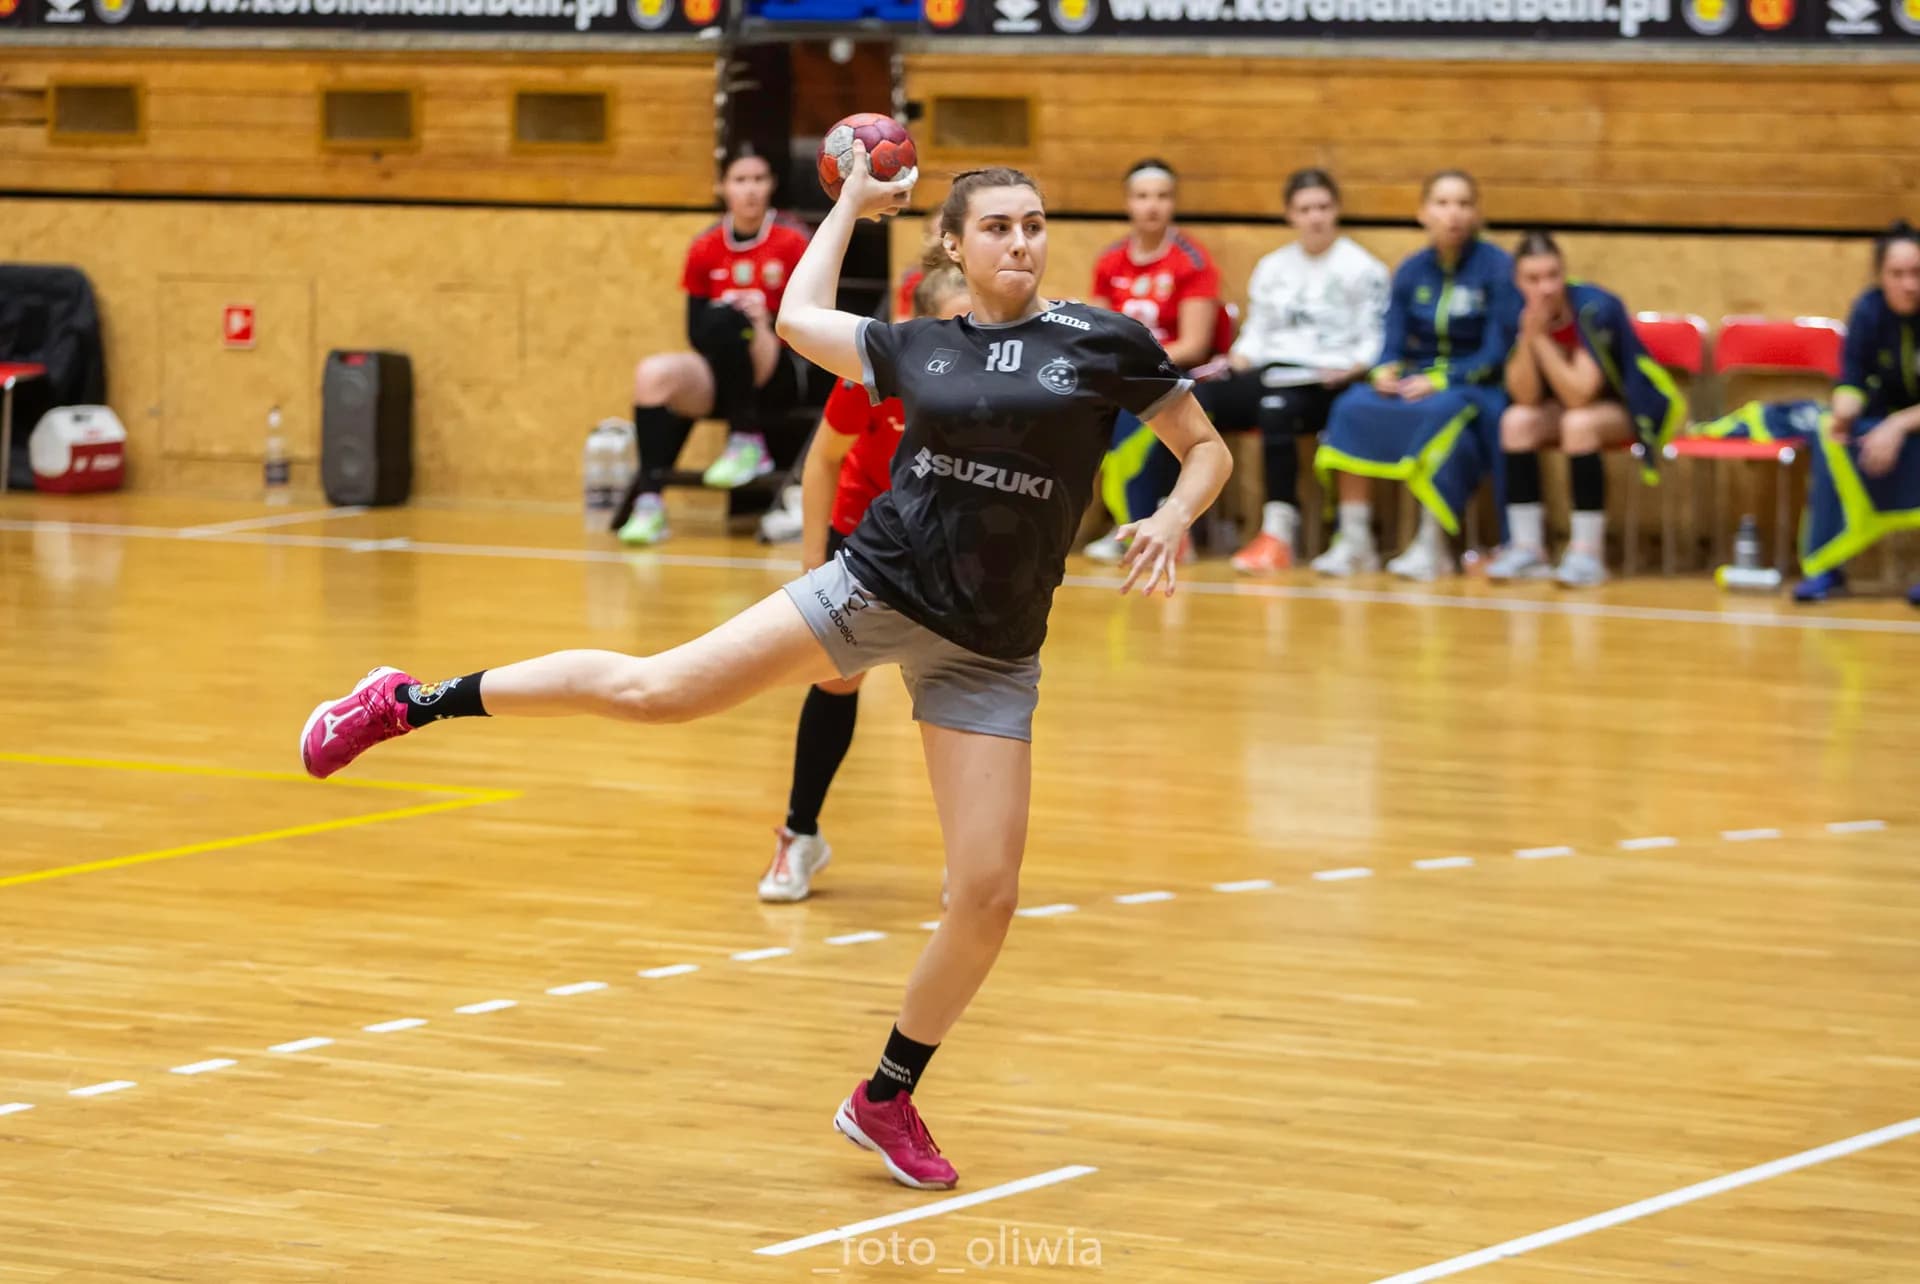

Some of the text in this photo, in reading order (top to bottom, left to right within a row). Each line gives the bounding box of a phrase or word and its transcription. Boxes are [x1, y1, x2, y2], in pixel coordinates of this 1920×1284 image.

[927, 359, 951, 374] CK
[985, 339, 1024, 372] 10
[930, 454, 1054, 500] SUZUKI
[814, 588, 856, 644] karabela
